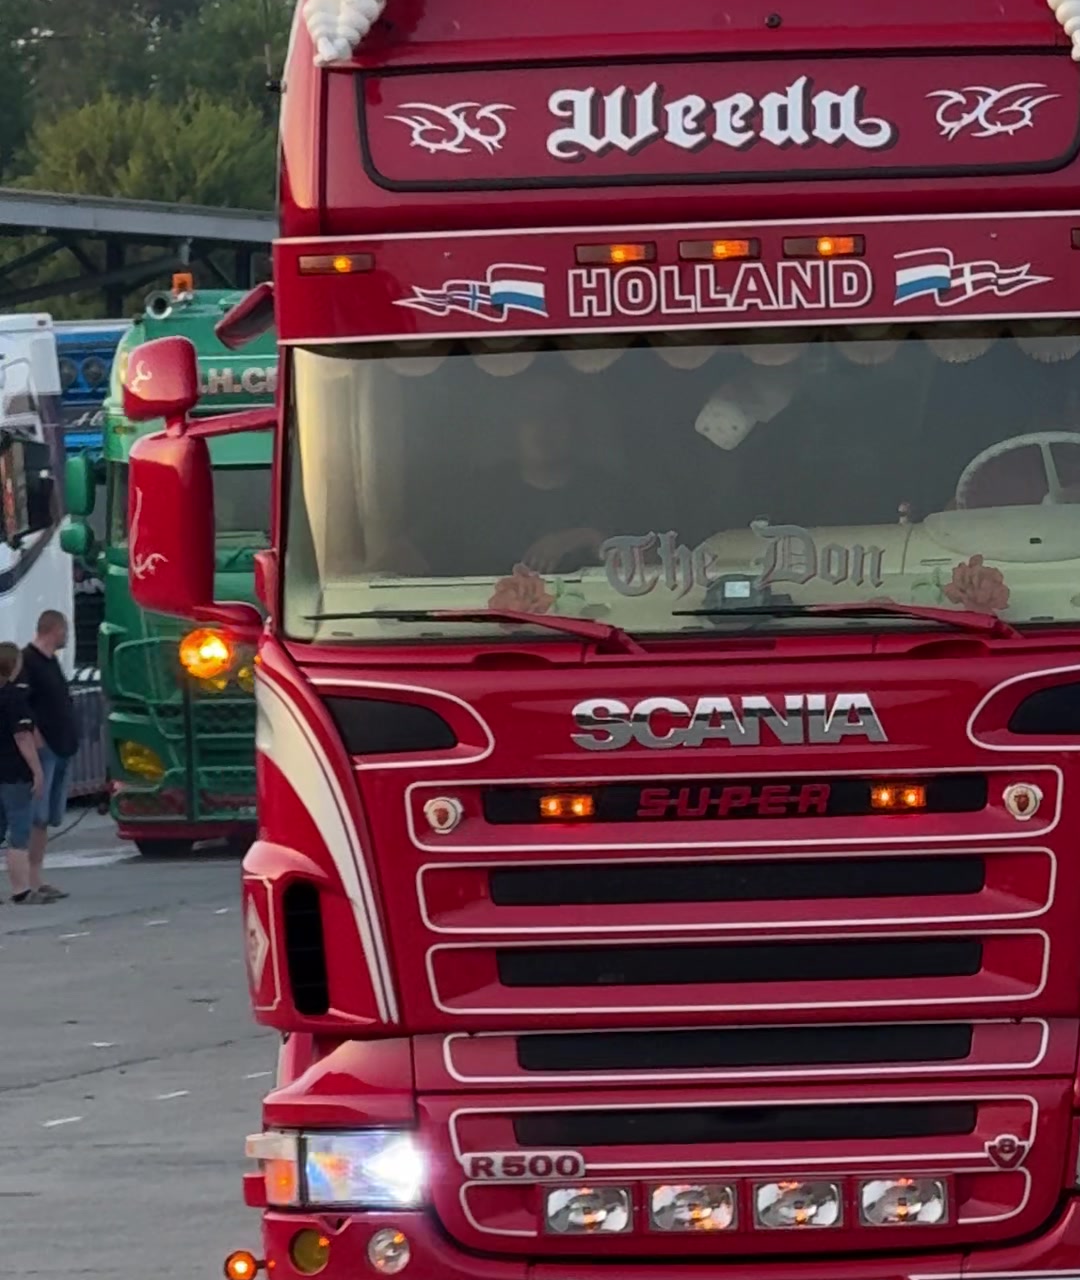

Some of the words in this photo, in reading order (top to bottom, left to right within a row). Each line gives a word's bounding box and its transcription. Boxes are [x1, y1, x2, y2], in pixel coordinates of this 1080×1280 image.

[546, 75, 894, 159] Weeda
[567, 260, 873, 317] HOLLAND
[601, 530, 719, 600] The
[749, 517, 886, 590] Don
[570, 693, 888, 751] SCANIA
[637, 783, 831, 818] SUPER
